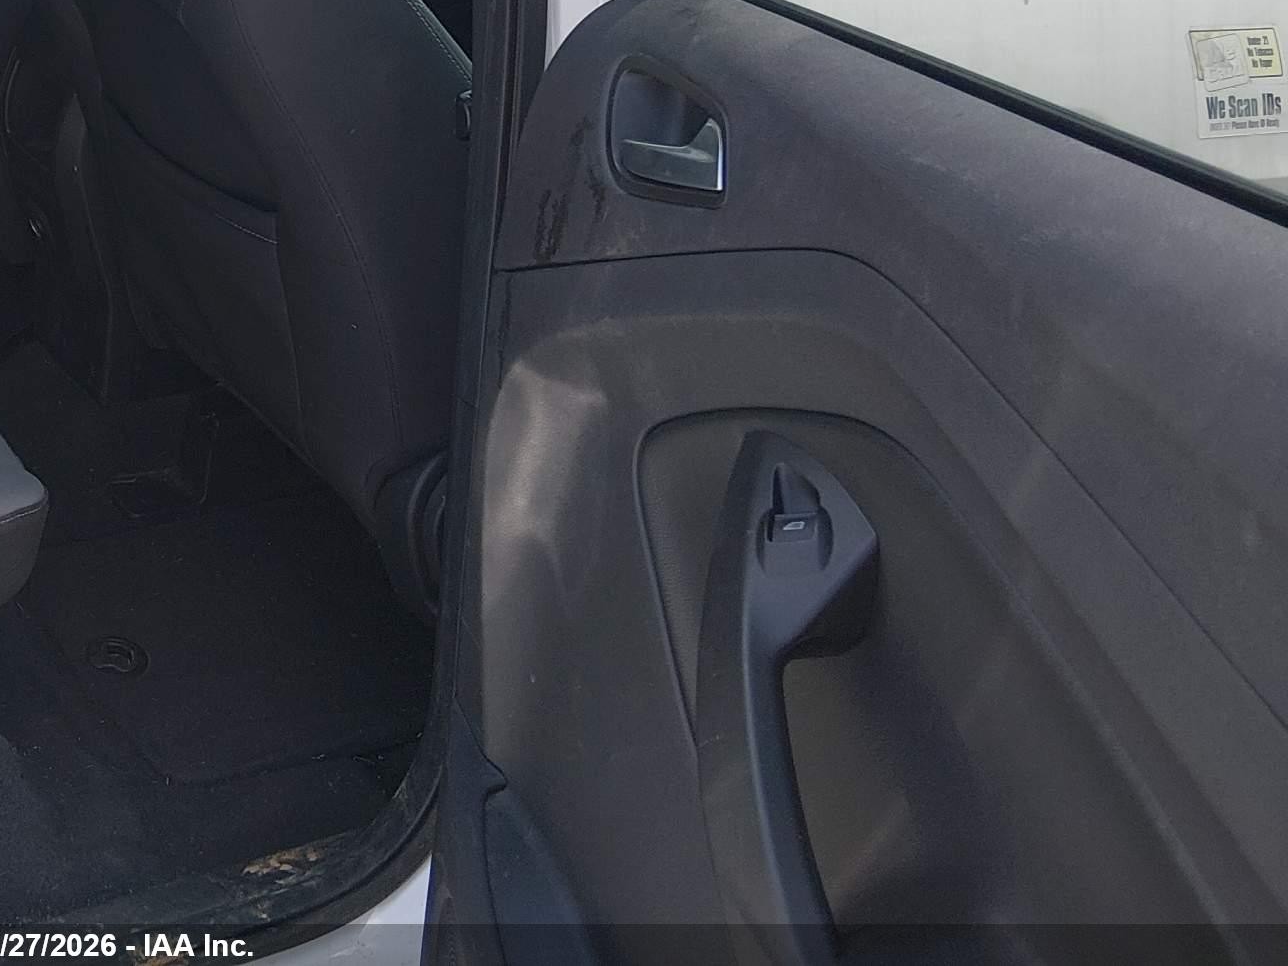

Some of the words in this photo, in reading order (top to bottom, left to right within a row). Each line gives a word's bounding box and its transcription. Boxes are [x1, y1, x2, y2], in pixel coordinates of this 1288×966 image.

[1206, 96, 1226, 120] We
[1228, 95, 1259, 119] Scan
[1262, 92, 1282, 116] IDs
